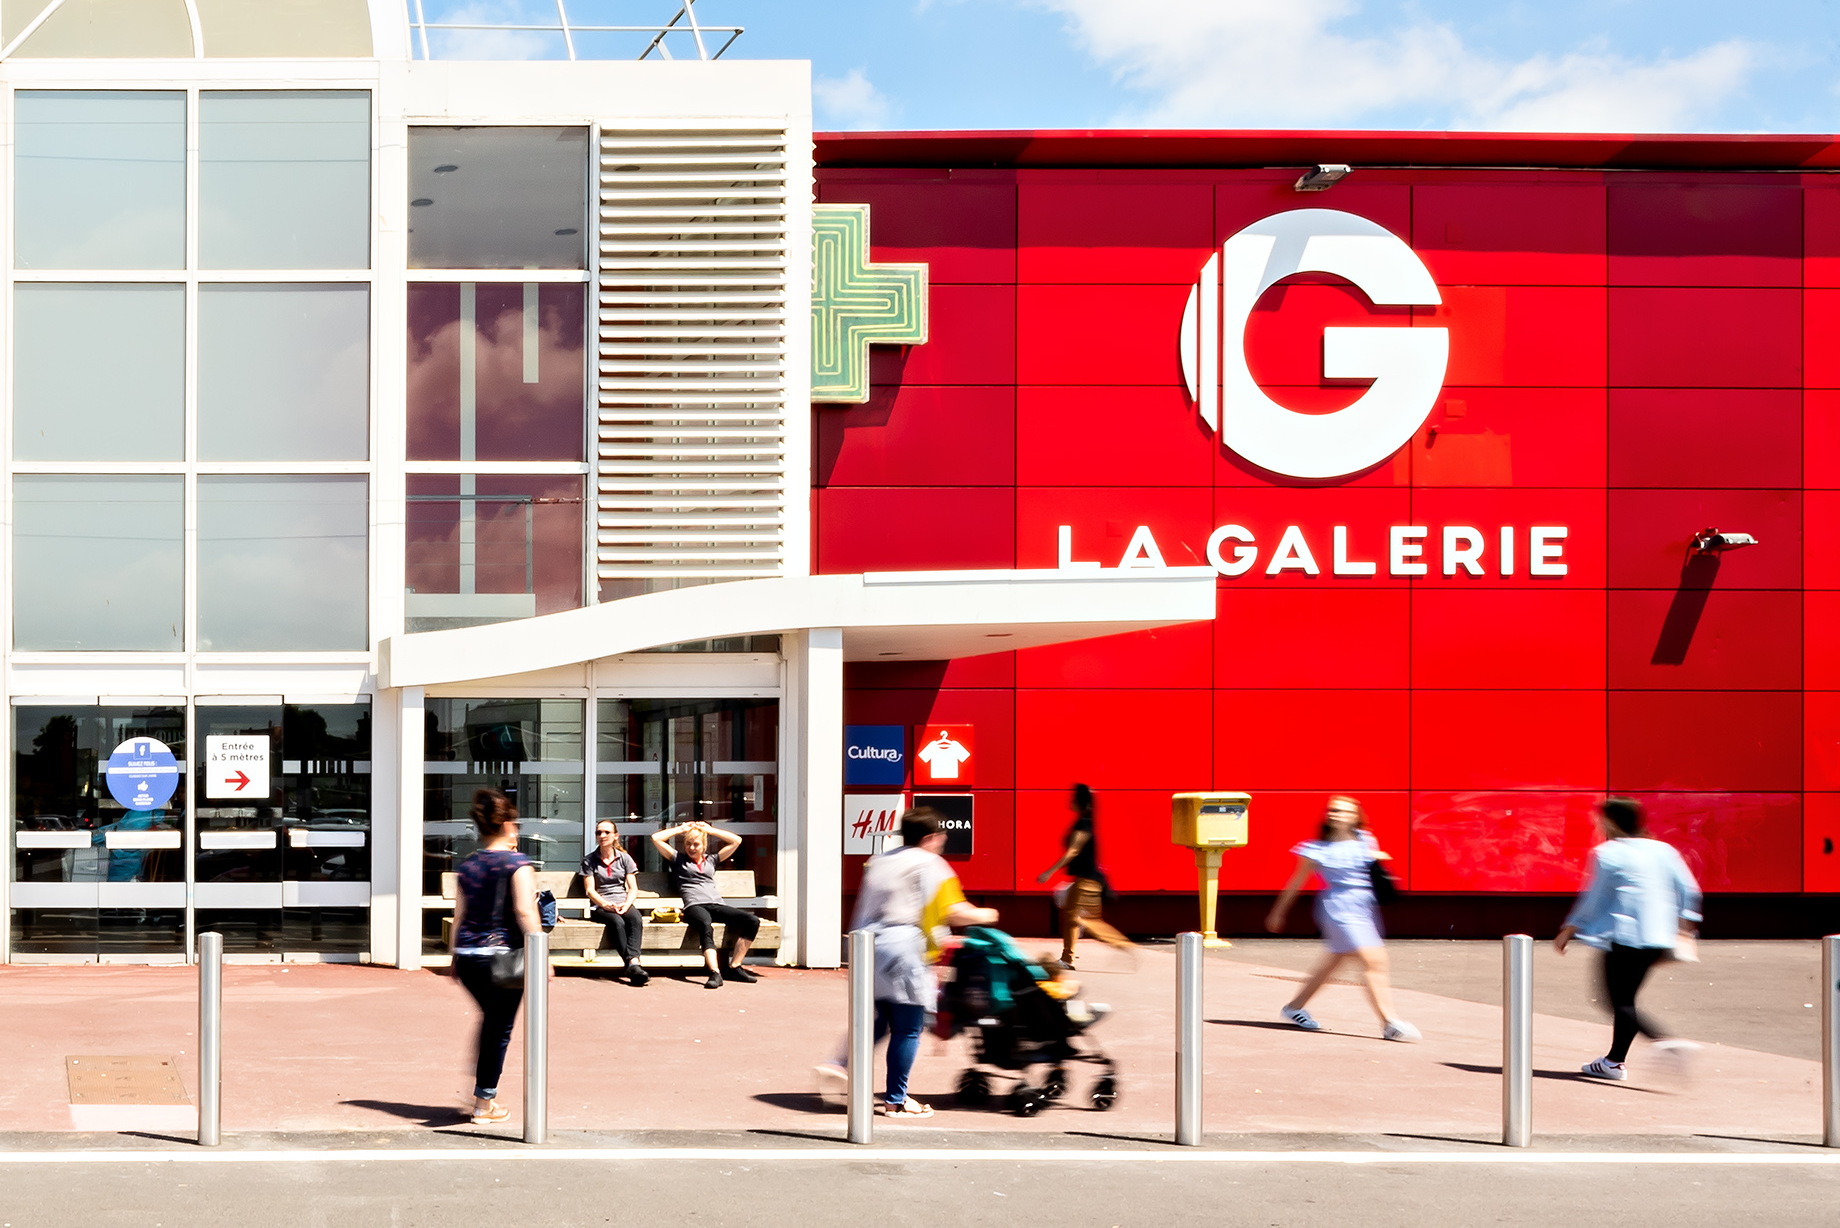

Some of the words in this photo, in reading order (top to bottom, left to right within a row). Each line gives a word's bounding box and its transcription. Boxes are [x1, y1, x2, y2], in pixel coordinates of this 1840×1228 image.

[1180, 209, 1450, 478] G
[1058, 525, 1168, 568] LA
[1206, 524, 1569, 576] GALERIE
[212, 753, 218, 762] à
[221, 753, 227, 762] 5
[230, 753, 264, 762] mètres
[221, 742, 255, 751] Entrée
[847, 745, 903, 763] Cultura
[852, 809, 897, 839] H&M
